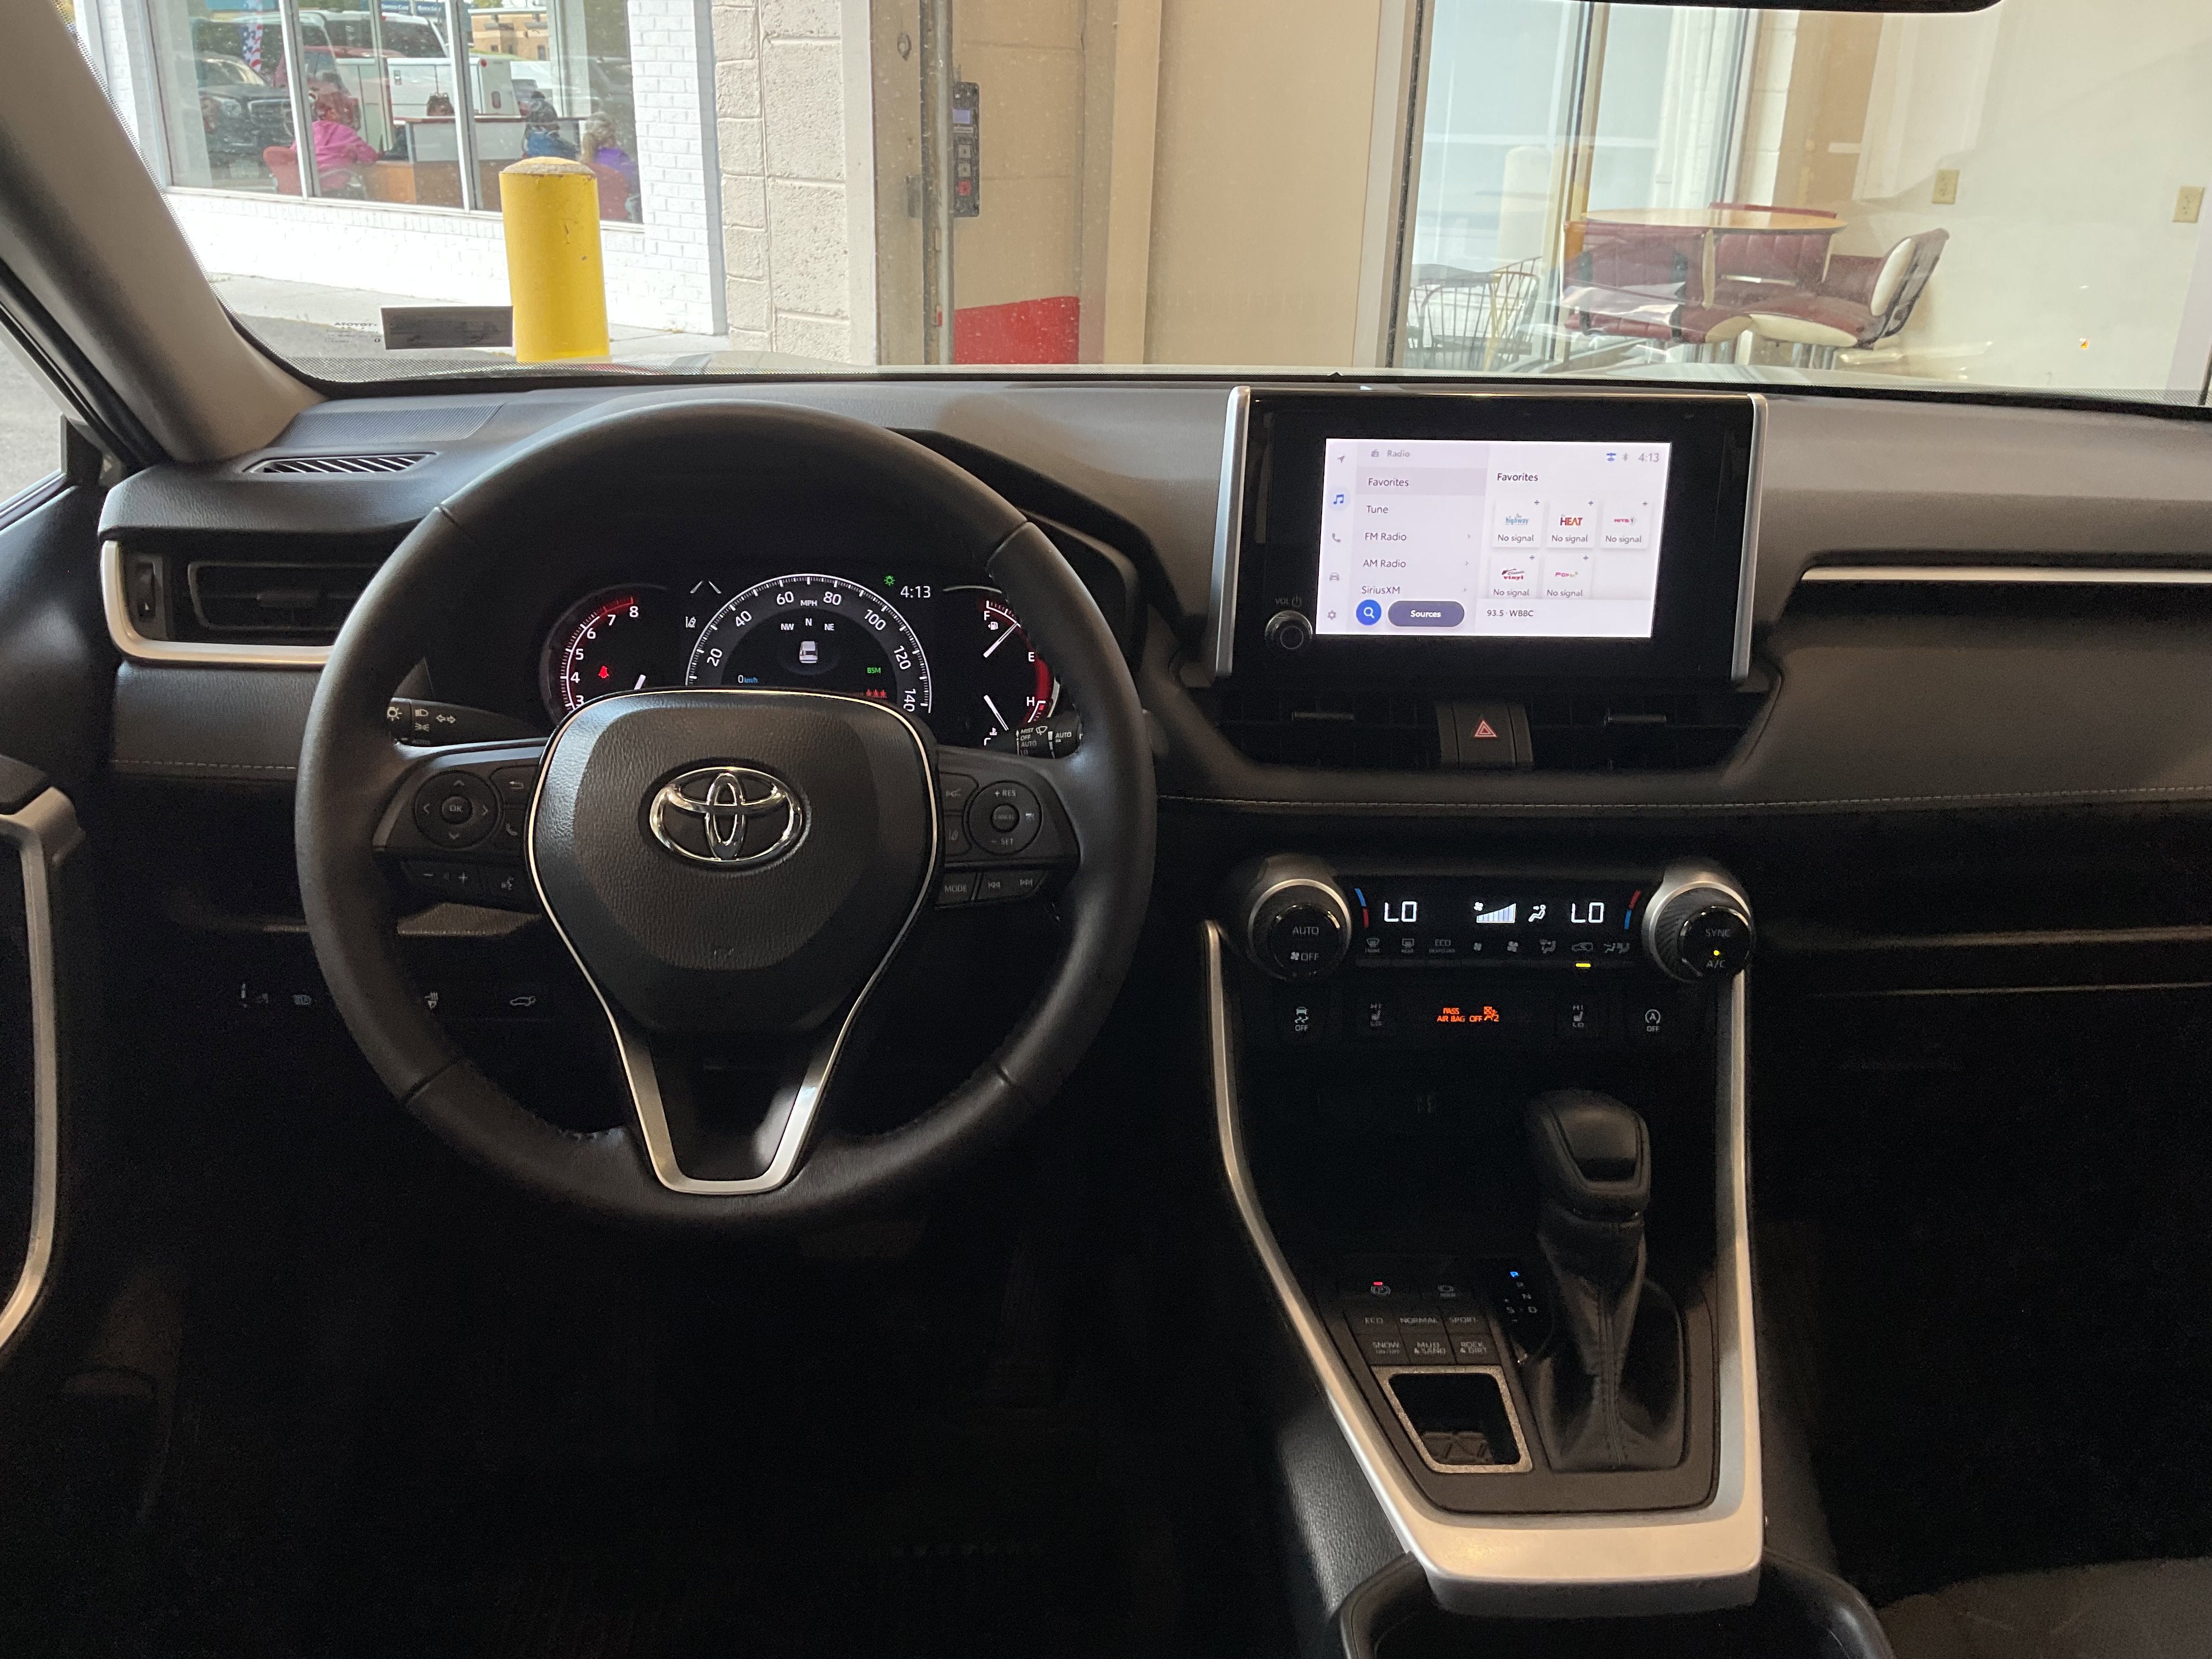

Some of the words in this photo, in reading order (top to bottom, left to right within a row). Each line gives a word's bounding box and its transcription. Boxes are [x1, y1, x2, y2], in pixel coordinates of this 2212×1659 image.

[1638, 453, 1660, 462] 4:13
[1497, 473, 1538, 481] Favorites
[1368, 478, 1409, 487] Favorites
[1366, 505, 1389, 514] Tune
[1560, 517, 1583, 526] HEAT
[1380, 533, 1407, 541] Radio
[1511, 534, 1534, 543] signal
[1565, 535, 1588, 544] signal
[1619, 535, 1641, 544] signal
[1380, 560, 1406, 568] Radio
[900, 585, 931, 598] 4:13
[1362, 586, 1400, 594] SiriusXM
[1506, 589, 1530, 597] signal
[1560, 589, 1583, 598] signal
[776, 591, 794, 605] 60
[823, 591, 842, 606] 80
[629, 606, 639, 618] 8
[984, 611, 990, 620] F
[1410, 610, 1441, 618] Sources
[607, 614, 616, 626] 7
[735, 611, 752, 627] 40
[805, 618, 812, 626] N
[864, 609, 887, 630] 100
[586, 628, 596, 639] 6
[575, 648, 584, 660] 5
[707, 648, 723, 667] 20
[894, 645, 911, 669] 120
[1028, 652, 1035, 662] E
[571, 672, 580, 684] 4
[575, 695, 585, 707] 3
[903, 689, 916, 712] 140
[1026, 697, 1035, 706] H
[944, 884, 967, 893] MODE
[1384, 901, 1418, 922] LO
[1571, 901, 1604, 923] LO
[1292, 926, 1319, 935] AUTO
[1705, 928, 1731, 938] SYNC
[1300, 952, 1319, 961] OFF
[1706, 959, 1726, 969] A/C
